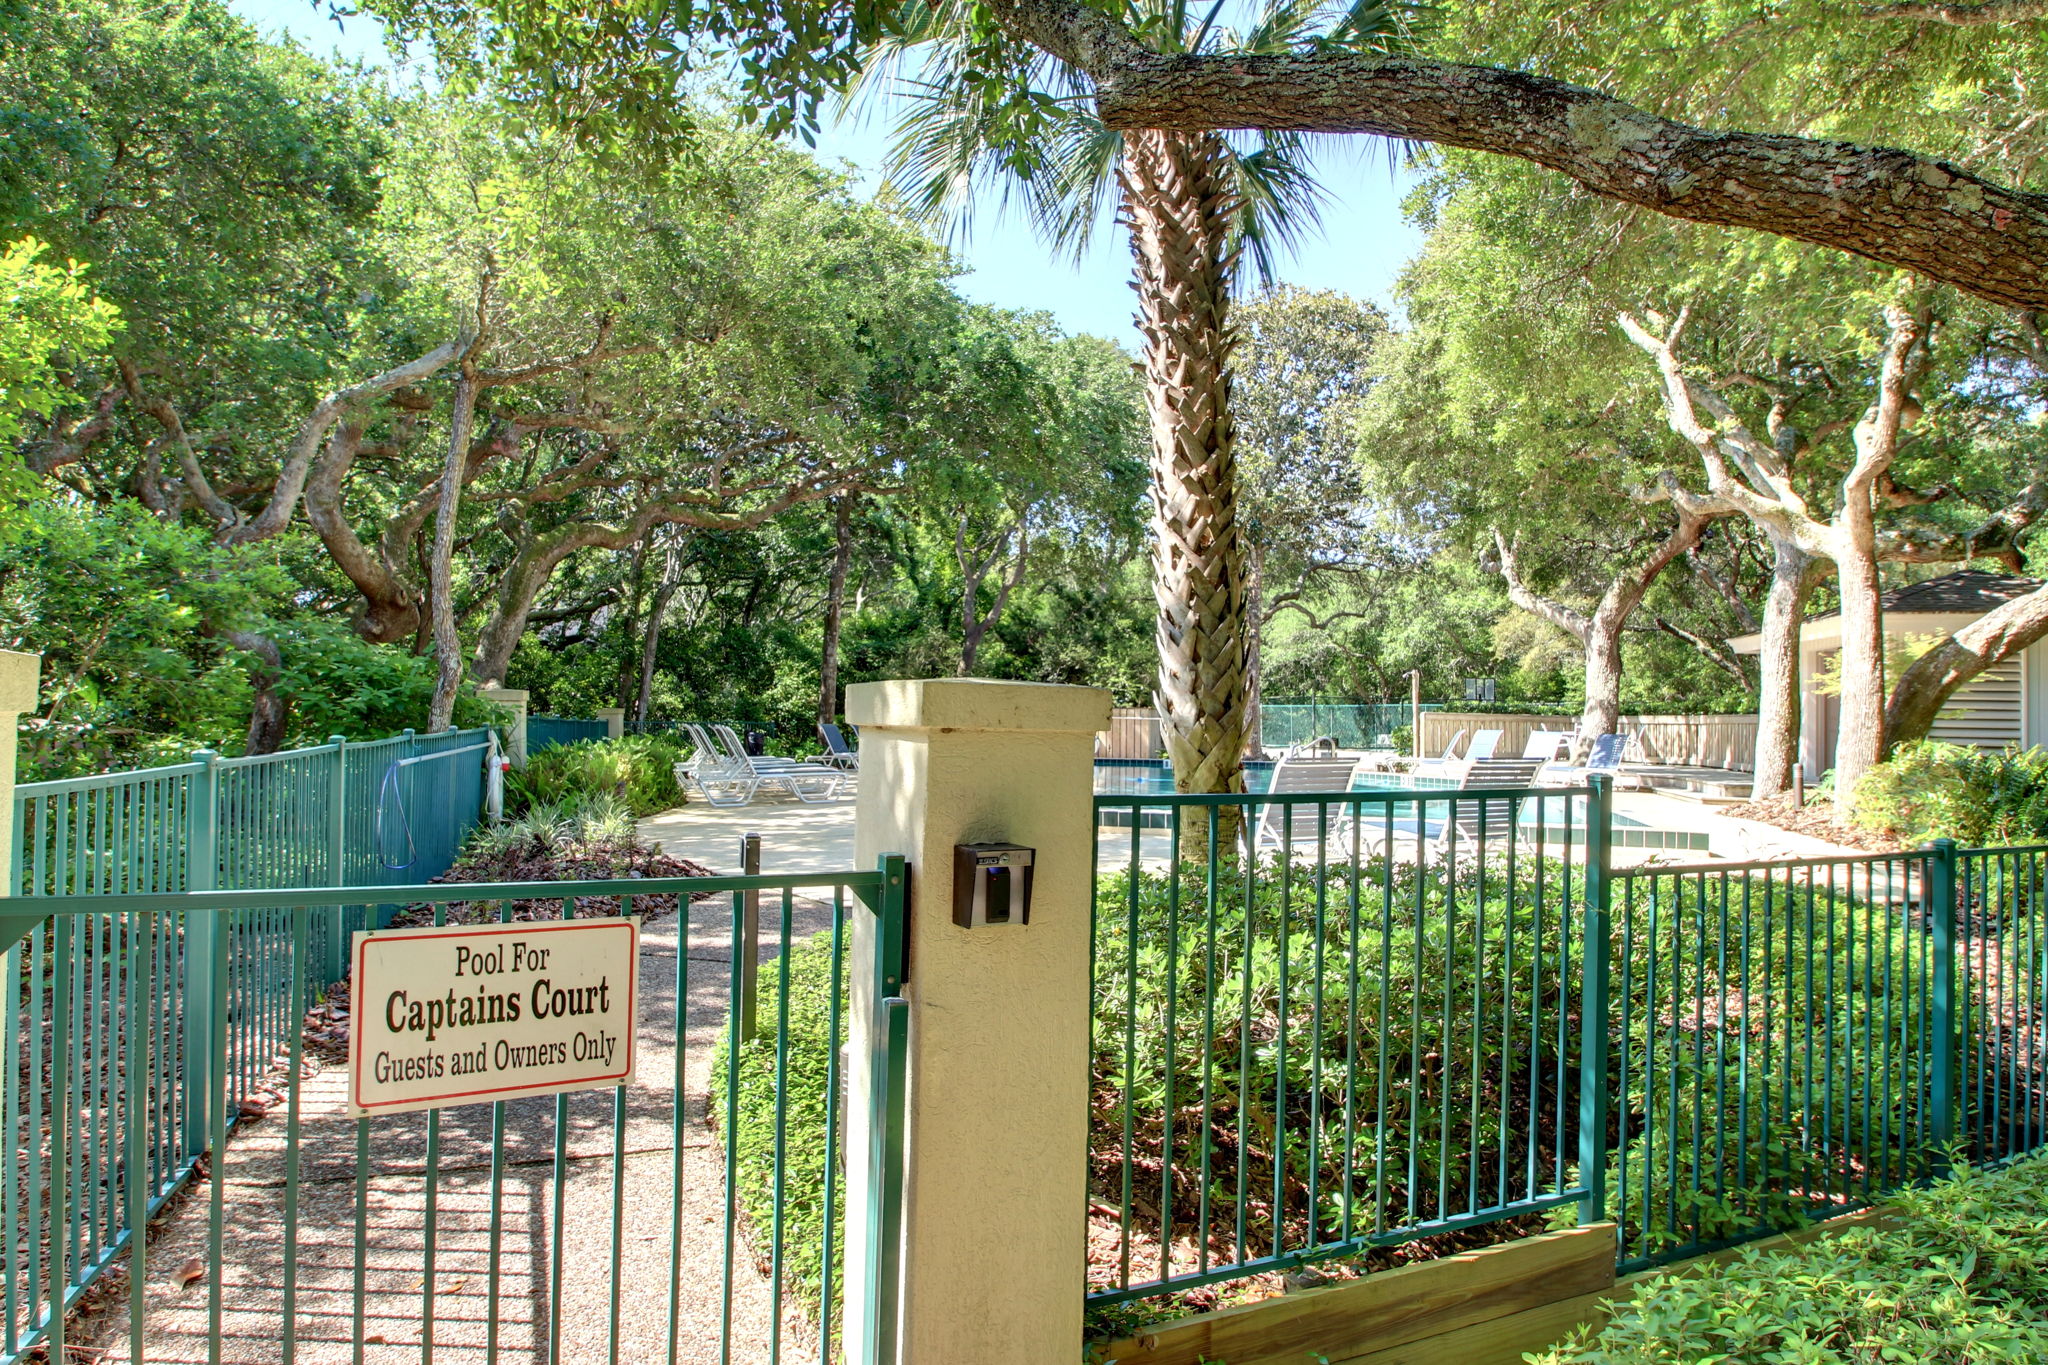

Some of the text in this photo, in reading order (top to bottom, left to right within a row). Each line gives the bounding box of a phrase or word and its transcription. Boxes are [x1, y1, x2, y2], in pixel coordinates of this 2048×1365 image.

[455, 942, 550, 977] Pool For
[386, 976, 610, 1042] Captains Court
[375, 1030, 616, 1084] Guests and Owners Only
